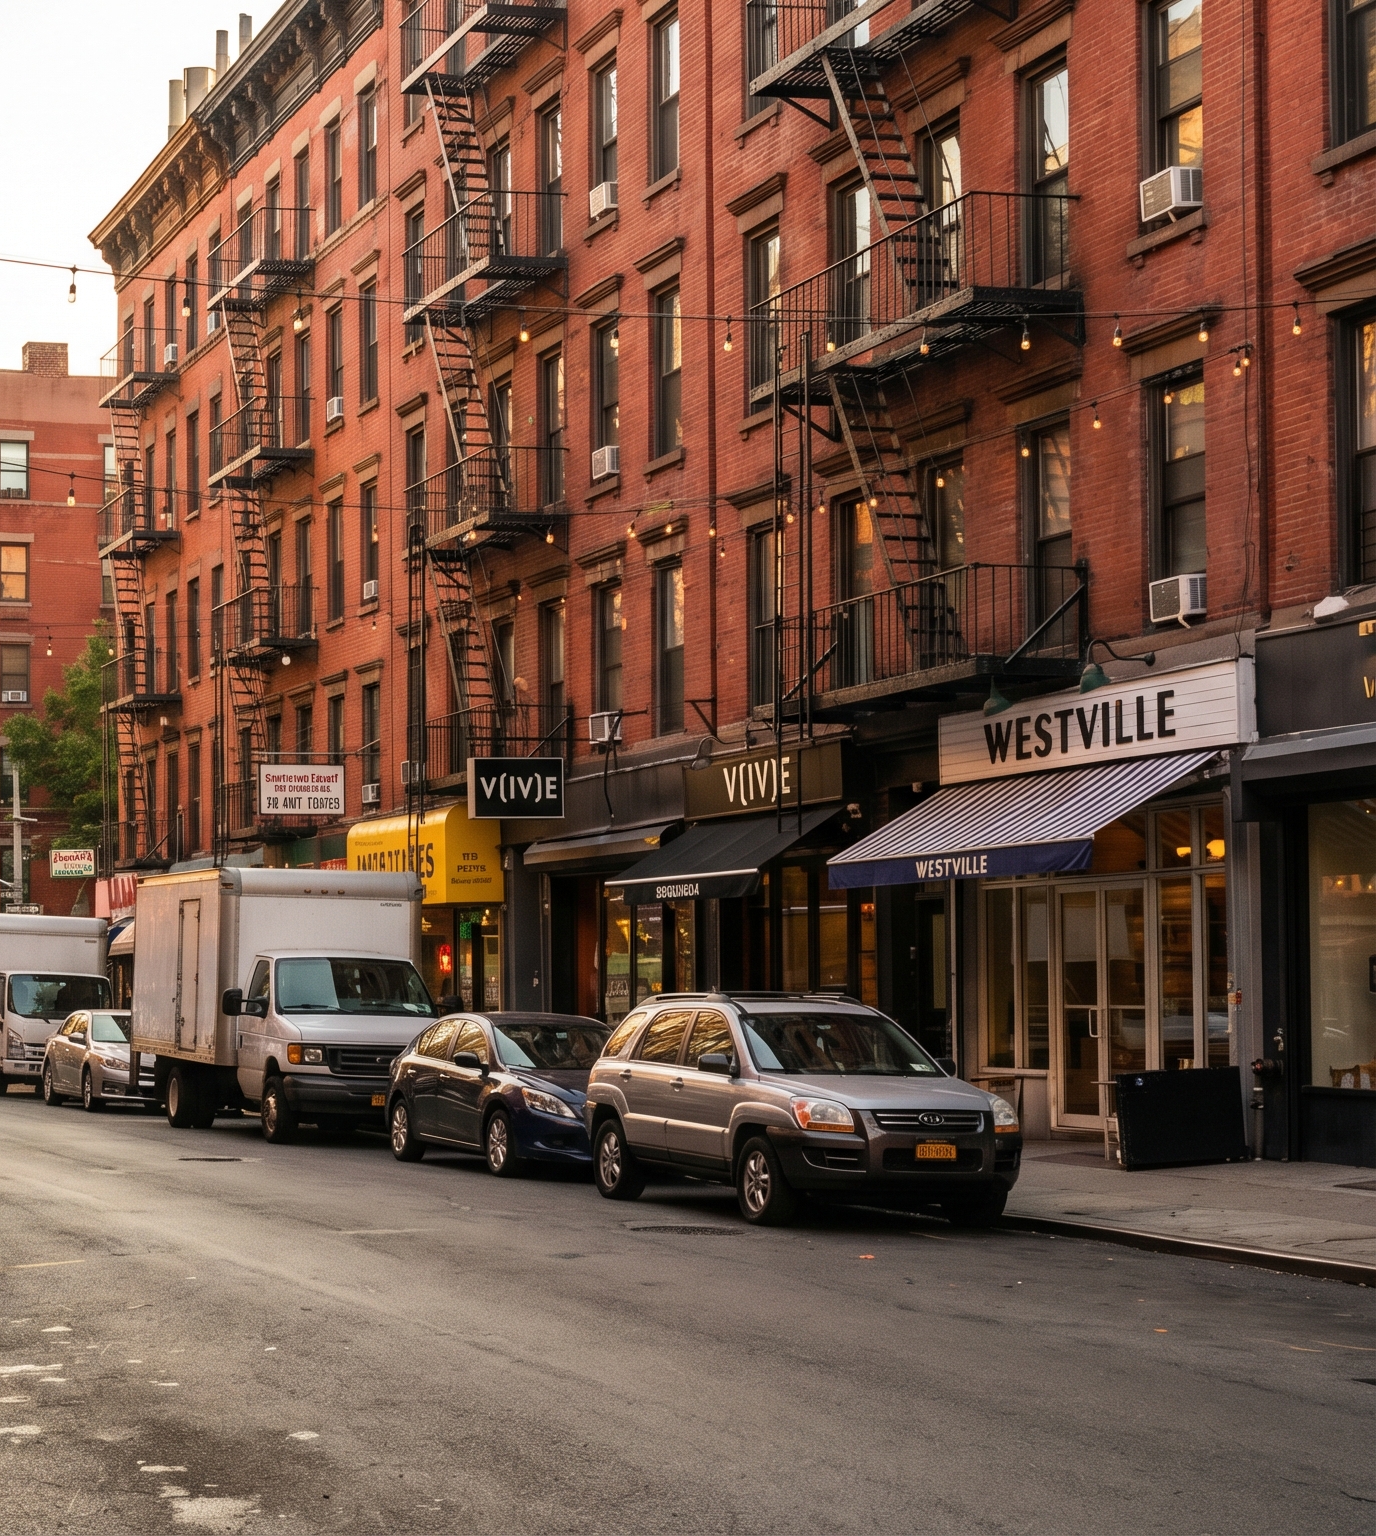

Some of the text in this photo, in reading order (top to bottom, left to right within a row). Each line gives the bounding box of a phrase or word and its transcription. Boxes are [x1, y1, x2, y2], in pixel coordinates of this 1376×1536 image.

[983, 689, 1176, 765] WESTVILLE
[479, 772, 557, 803] V(IV)E
[915, 855, 988, 878] WESTVILLE
